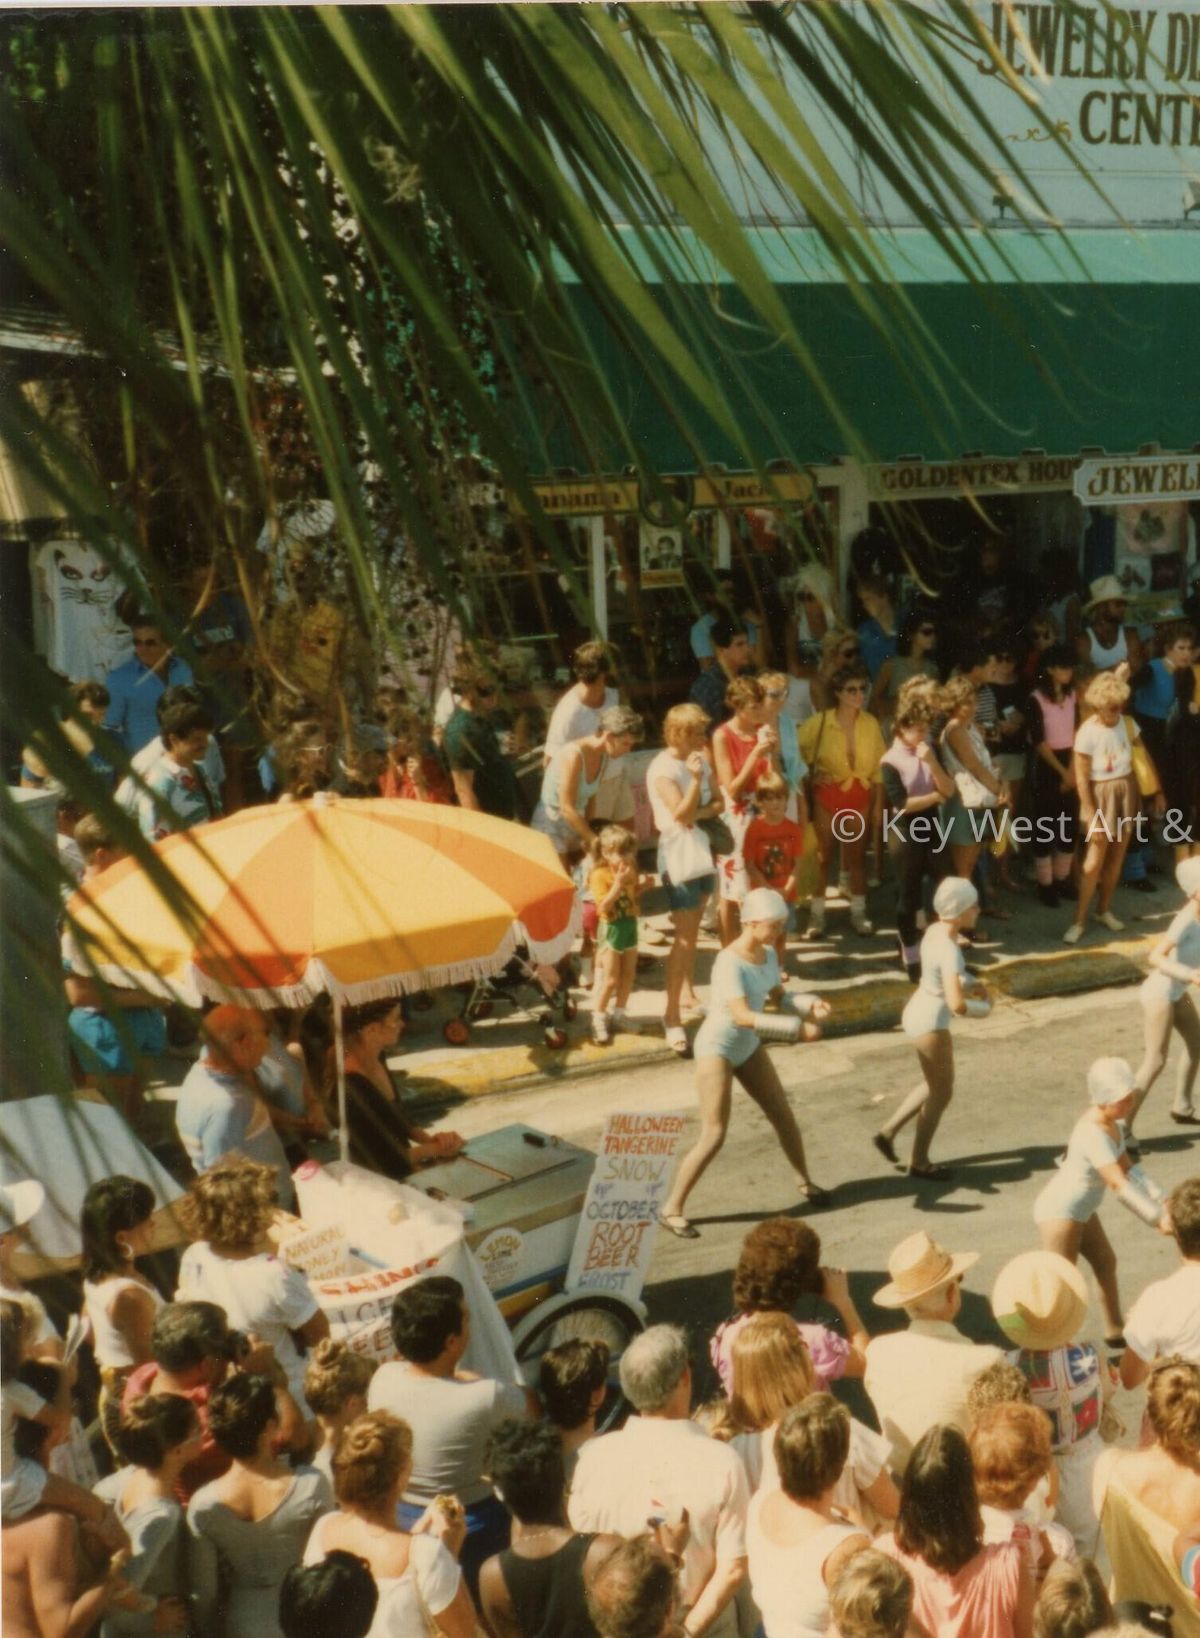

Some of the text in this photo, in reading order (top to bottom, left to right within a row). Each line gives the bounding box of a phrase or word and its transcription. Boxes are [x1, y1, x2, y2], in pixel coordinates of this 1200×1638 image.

[978, 2, 1156, 80] JEWELRY
[608, 1114, 685, 1134] HALLOWEEN
[604, 1136, 679, 1156] TANGERINE
[604, 1156, 667, 1181] SNOW
[587, 1201, 659, 1221] OCTOBER
[592, 1221, 651, 1248] ROOT
[583, 1246, 640, 1271] BEER
